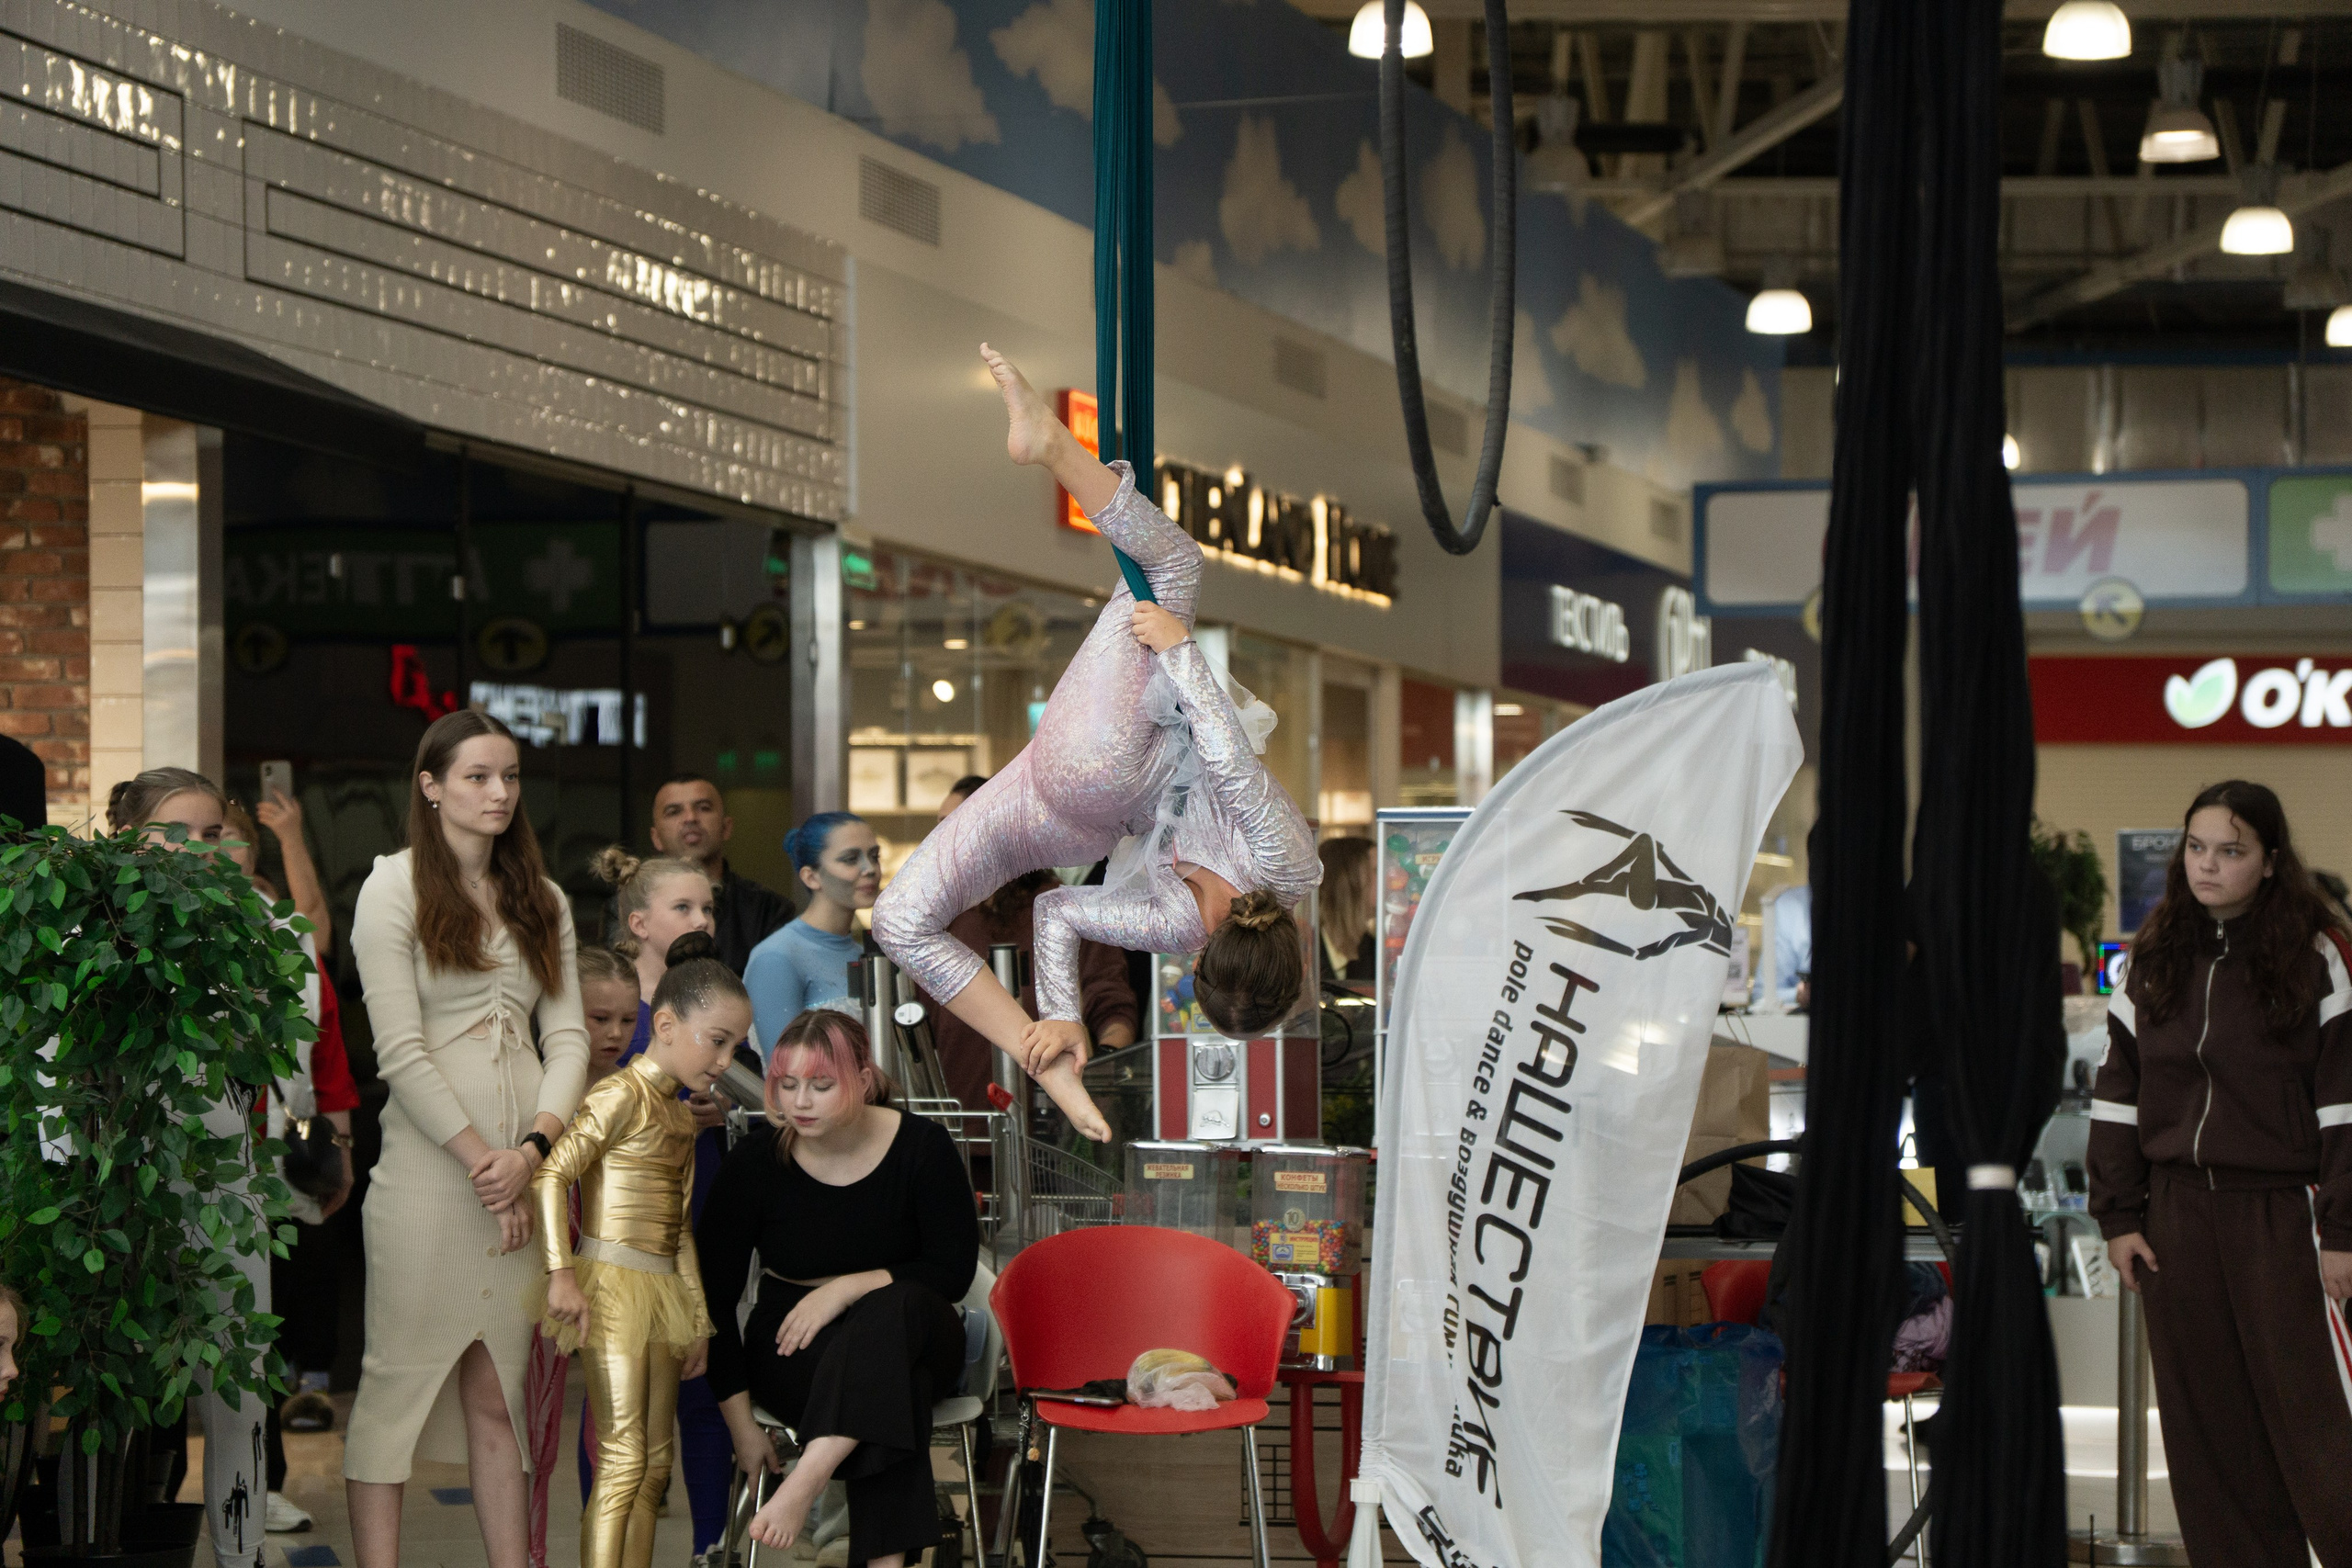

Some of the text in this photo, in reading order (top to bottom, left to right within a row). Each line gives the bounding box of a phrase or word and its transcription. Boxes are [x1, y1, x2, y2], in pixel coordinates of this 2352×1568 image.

[1500, 939, 1534, 1004] pole
[1473, 1009, 1514, 1095] dance
[1465, 1099, 1488, 1121] &
[1147, 1164, 1190, 1172] ЖЕВАТЕЛЬНАЯ
[1280, 1174, 1319, 1182] КОНФЕТЫ
[1309, 1184, 1327, 1192] ШТУК
